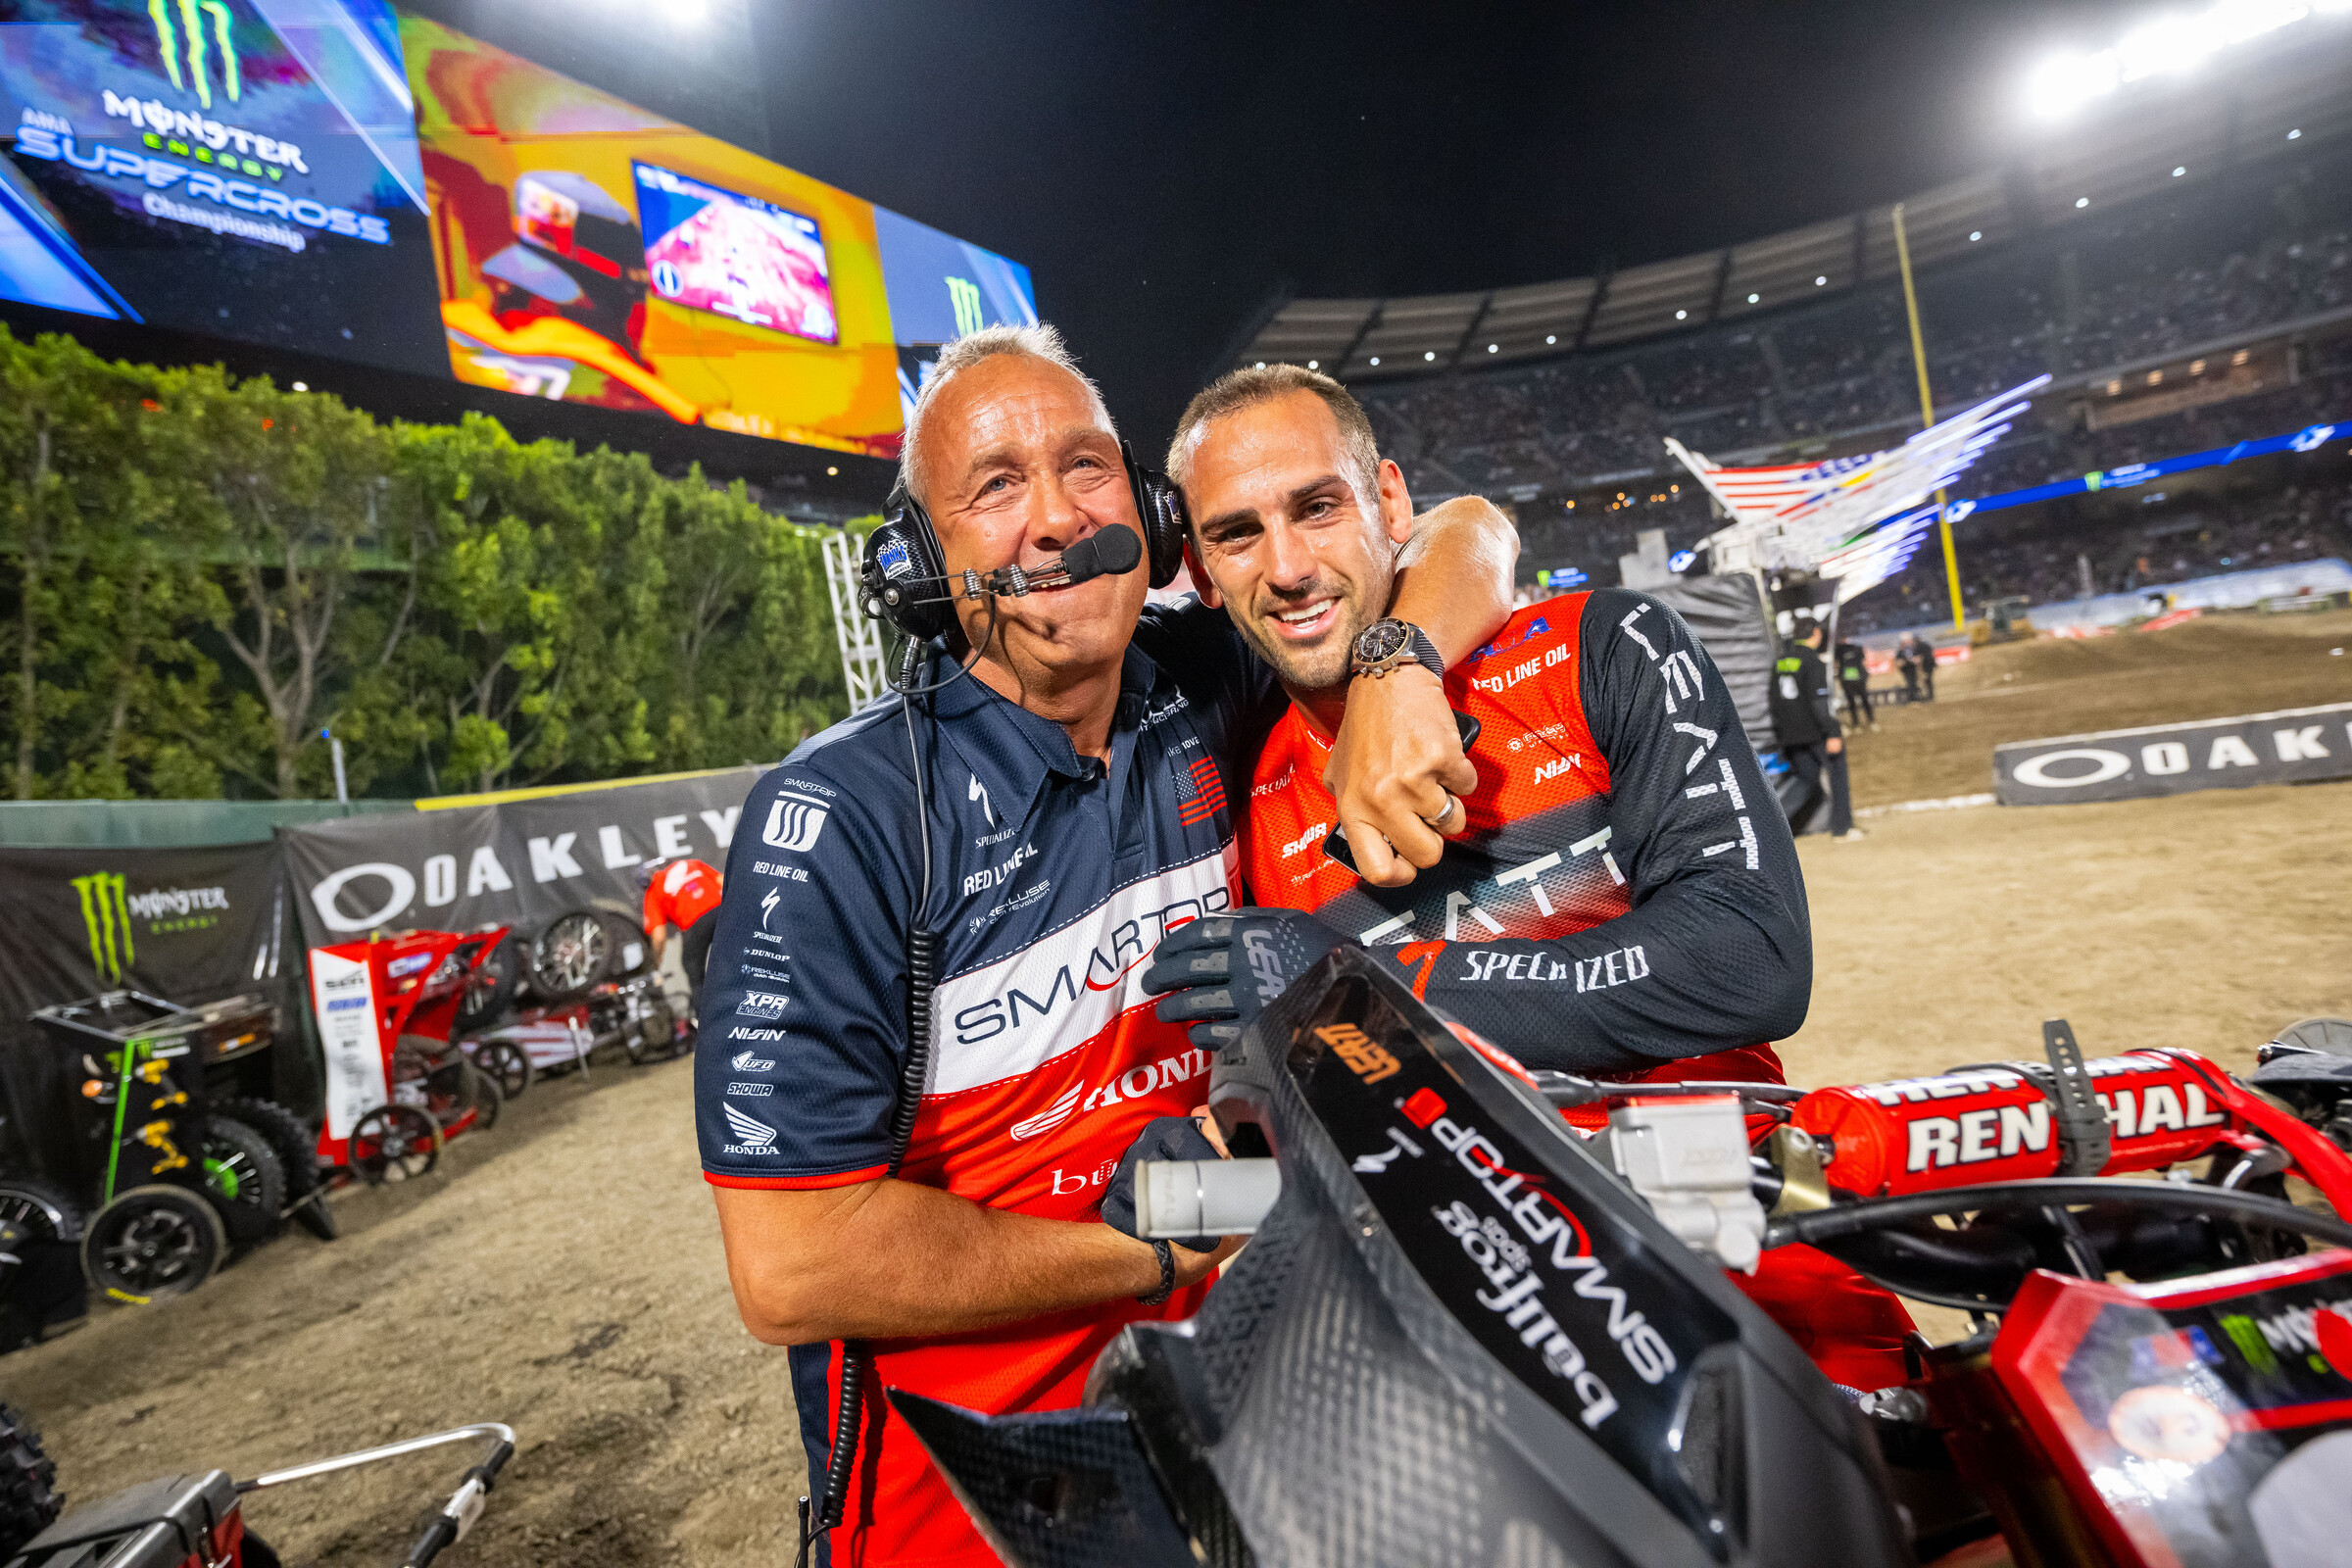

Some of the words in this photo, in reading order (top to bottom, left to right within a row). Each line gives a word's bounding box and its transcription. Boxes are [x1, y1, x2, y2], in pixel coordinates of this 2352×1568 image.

[102, 89, 310, 174] MONSTER
[14, 124, 391, 245] SUPERCROSS
[142, 192, 306, 254] Championship
[1505, 656, 1542, 689] LINE
[1544, 643, 1571, 667] OIL
[2140, 720, 2352, 776] OAK
[784, 777, 837, 798] SMARTOP
[423, 805, 743, 907] OAKLEY
[975, 828, 1016, 849] SPECIALIZ
[1282, 822, 1327, 859] SHWA
[753, 860, 769, 874] RED
[769, 864, 791, 879] LINE
[792, 868, 808, 883] OIL
[964, 869, 993, 897] RED
[128, 886, 229, 919] MONSTER
[750, 949, 791, 961] DUNLOP
[954, 885, 1230, 1046] SMARTOP
[738, 1004, 780, 1018] ENGINES
[745, 1058, 775, 1070] UFO
[1314, 1023, 1402, 1085] LEATT
[727, 1082, 774, 1097] SHOWA
[1906, 1081, 2227, 1174] RENHAL
[722, 1144, 781, 1155] HONDA
[1431, 1117, 1678, 1385] SMARTOP
